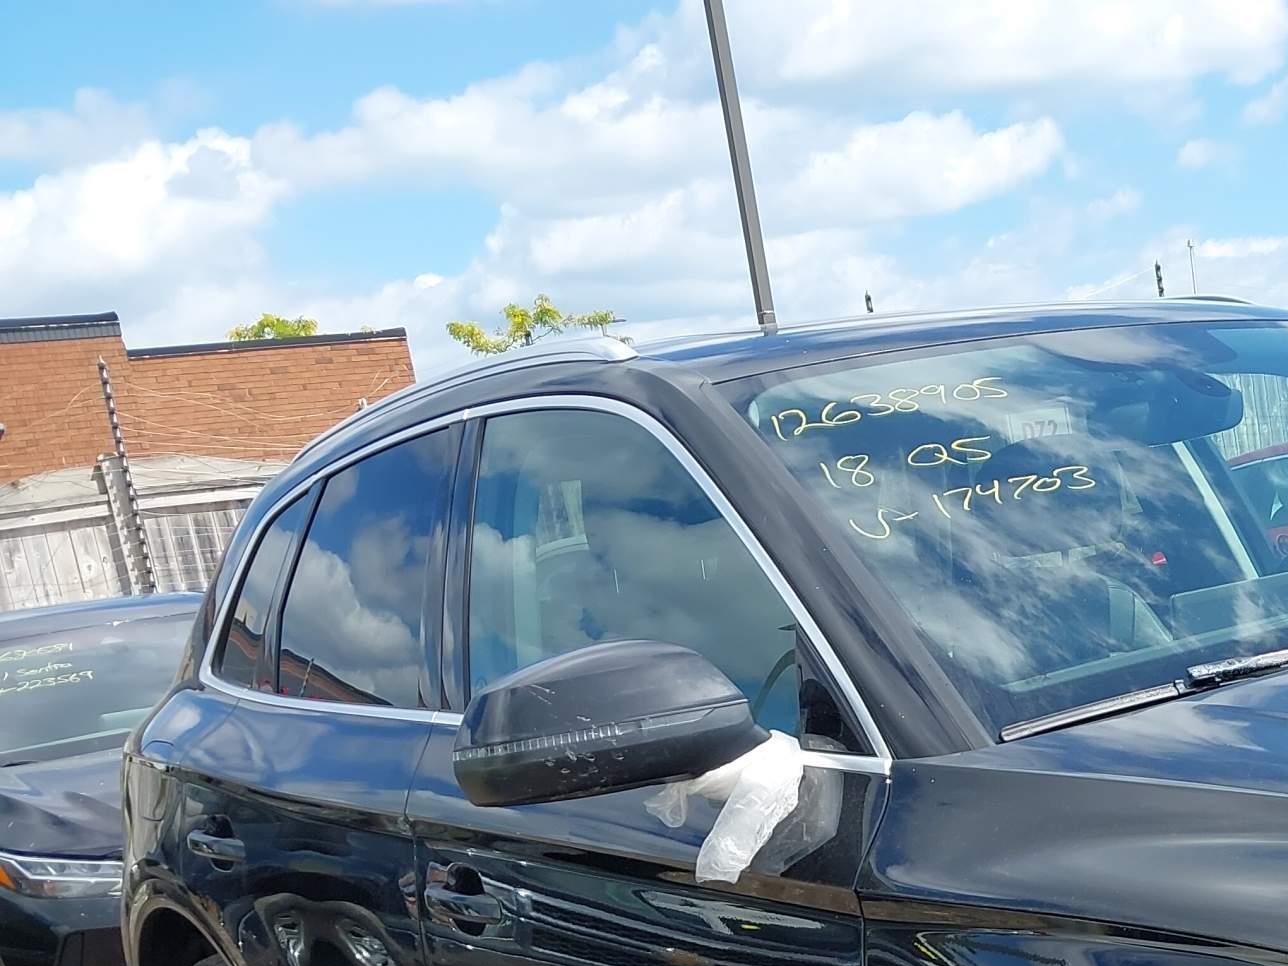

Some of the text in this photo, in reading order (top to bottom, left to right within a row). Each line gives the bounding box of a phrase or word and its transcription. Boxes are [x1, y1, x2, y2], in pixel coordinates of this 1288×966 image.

[770, 377, 1008, 442] 12638905
[820, 454, 874, 488] 18
[932, 465, 1096, 519] 174703
